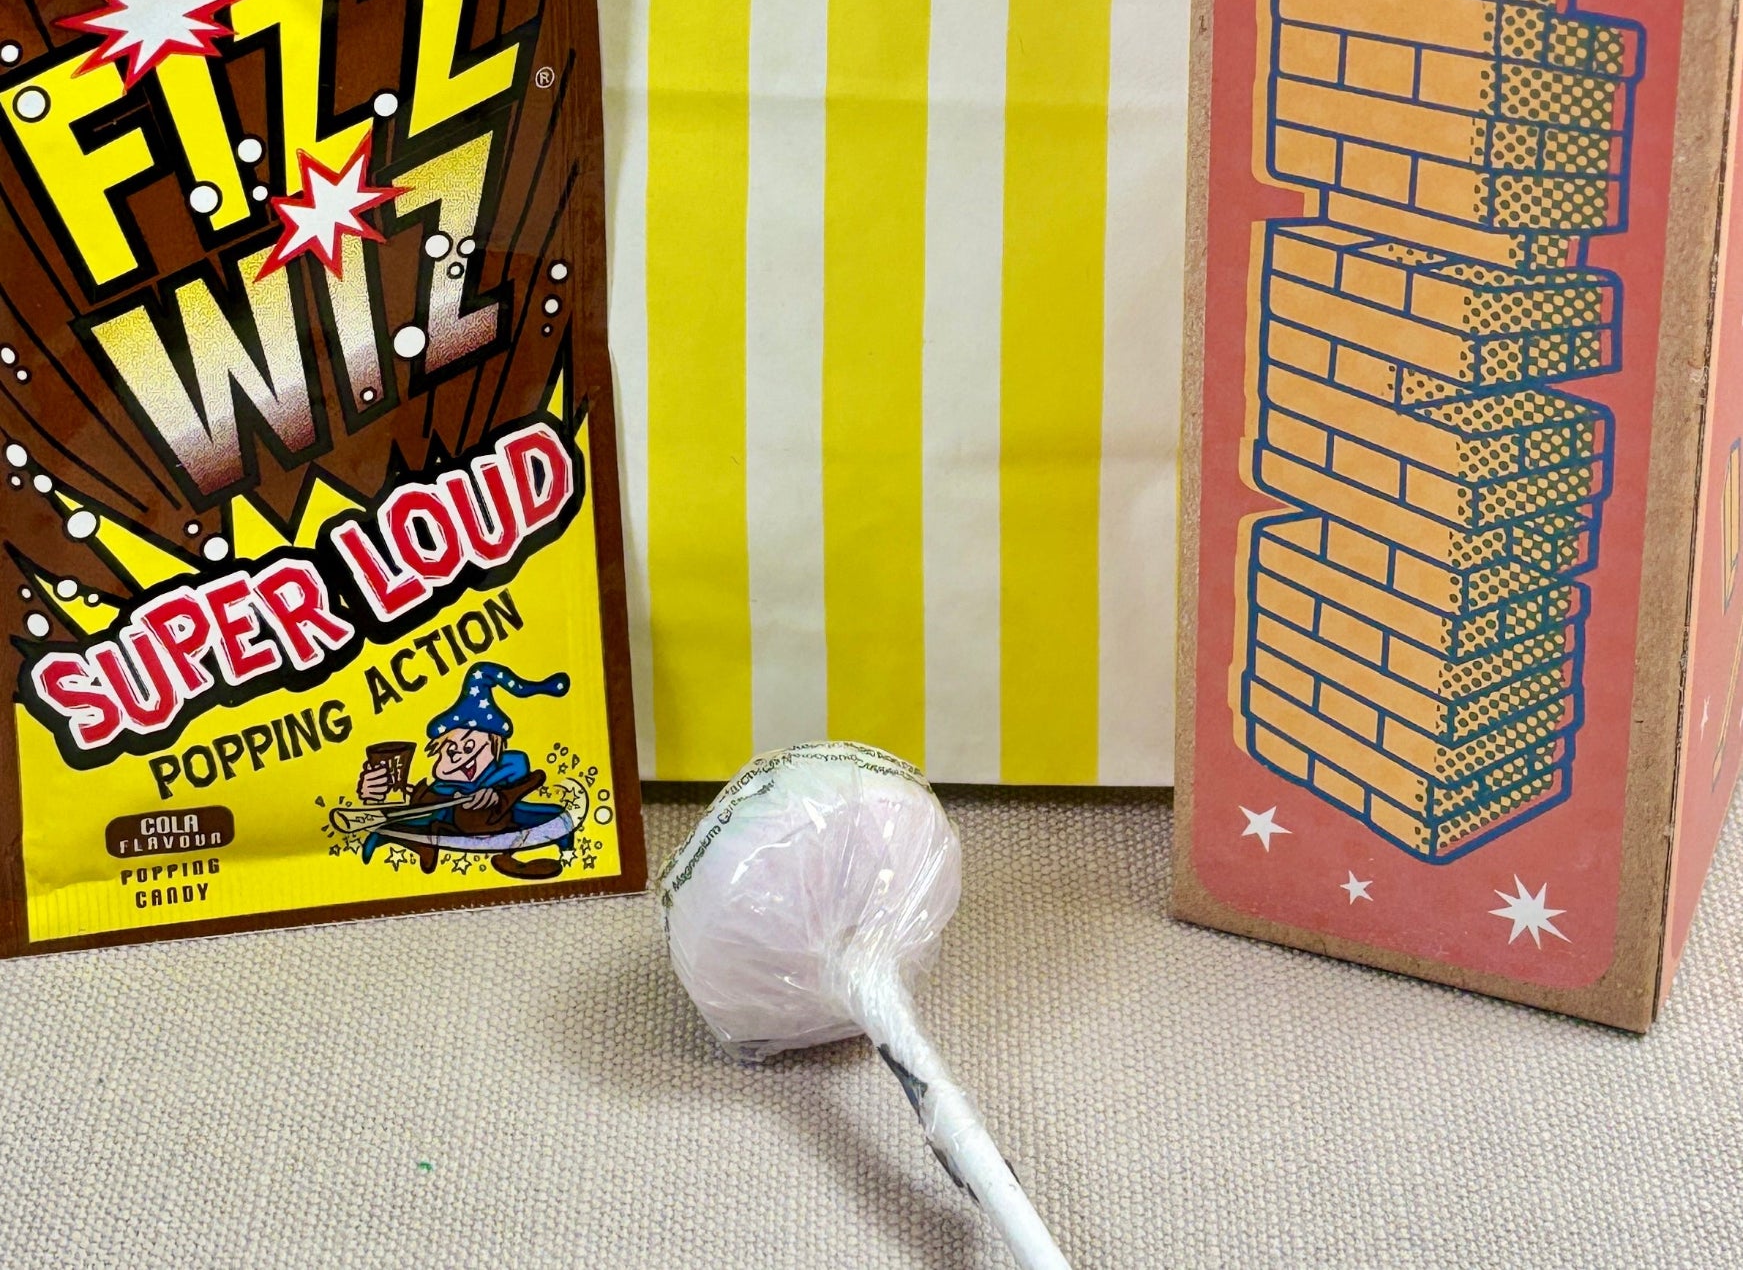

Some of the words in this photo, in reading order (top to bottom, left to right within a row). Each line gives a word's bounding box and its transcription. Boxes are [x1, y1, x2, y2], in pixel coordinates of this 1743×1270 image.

[88, 128, 504, 498] WIZ
[32, 557, 356, 751] SUPER
[330, 421, 575, 623] LOUD
[148, 701, 354, 801] POPPING
[363, 587, 525, 715] ACTION
[140, 813, 199, 836] COLA
[119, 831, 222, 854] FLAVOUR
[120, 857, 220, 886] POPPING
[135, 882, 209, 909] CANDY
